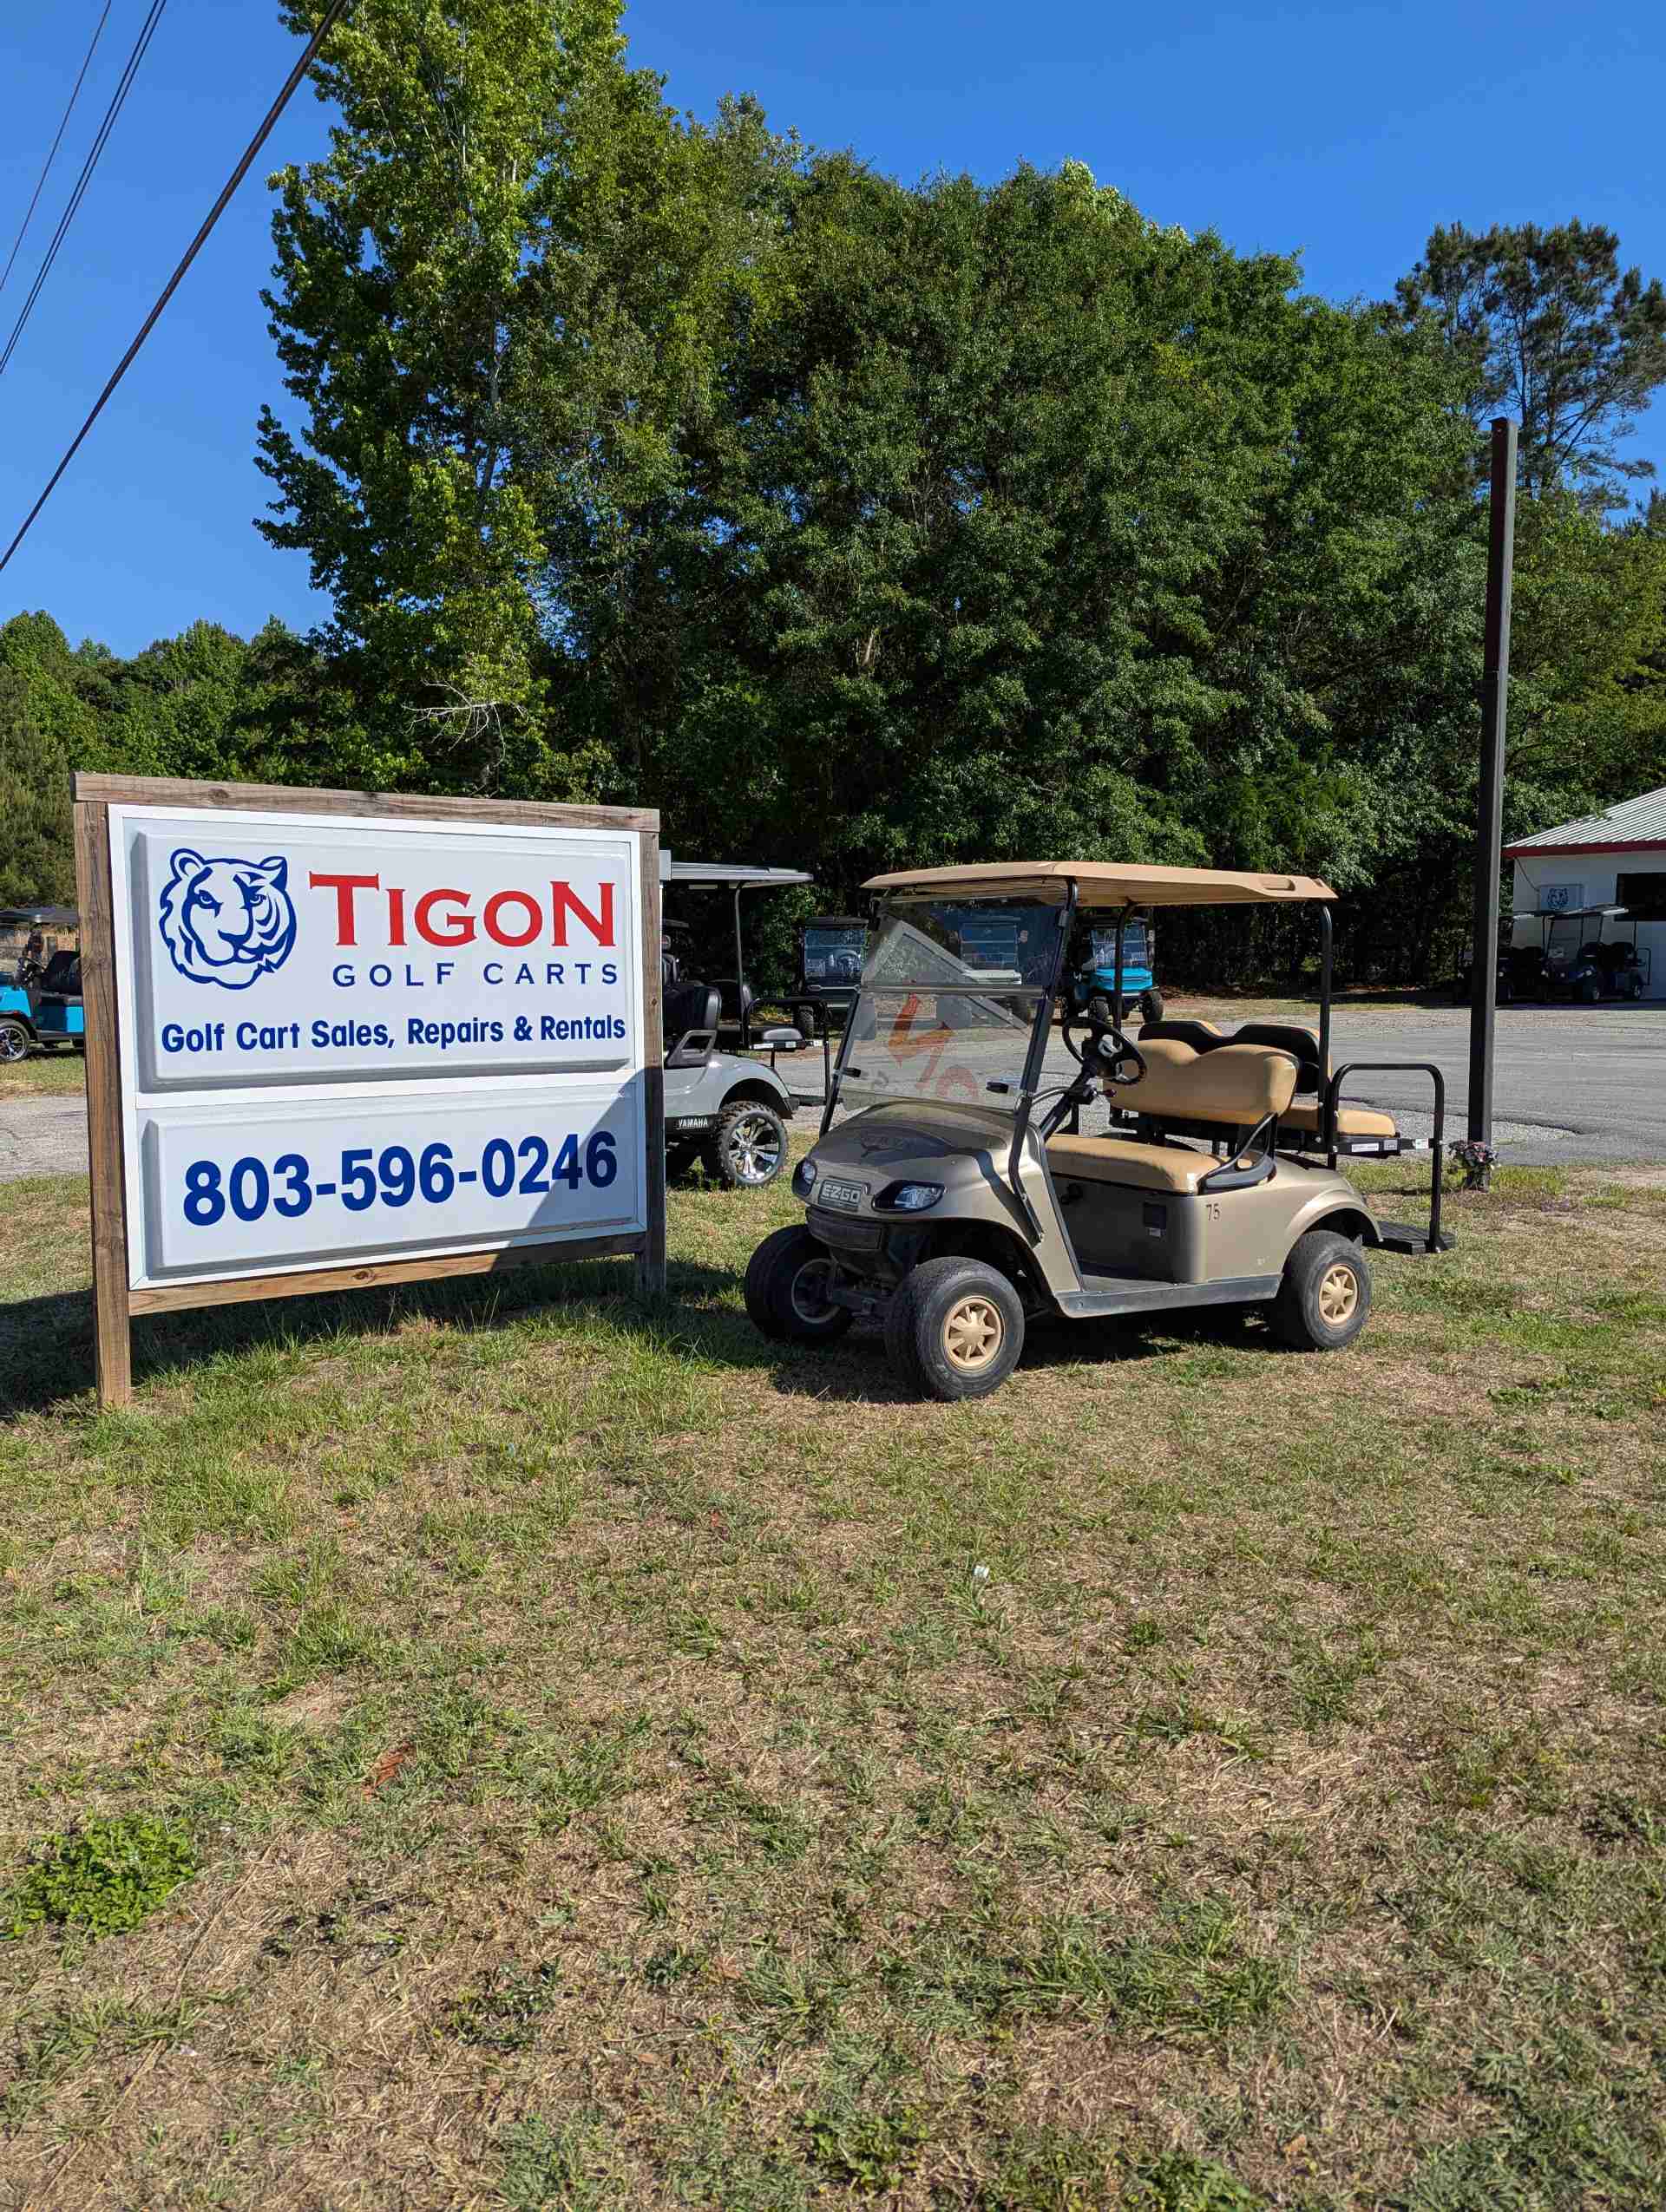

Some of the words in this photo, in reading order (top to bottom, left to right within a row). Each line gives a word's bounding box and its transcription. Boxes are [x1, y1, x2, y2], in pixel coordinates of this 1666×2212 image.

[310, 873, 615, 947] TIGON
[332, 963, 455, 987] GOLF
[483, 963, 619, 985] CARTS
[161, 1023, 225, 1052] Golf
[236, 1023, 300, 1050] Cart
[311, 1018, 395, 1049] Sales,
[408, 1016, 504, 1050] Repairs
[514, 1016, 533, 1041] &
[541, 1015, 626, 1041] Rentals
[679, 1116, 709, 1129] YAMAHA
[183, 1131, 618, 1227] 803-596-0246
[1206, 1203, 1221, 1221] 75
